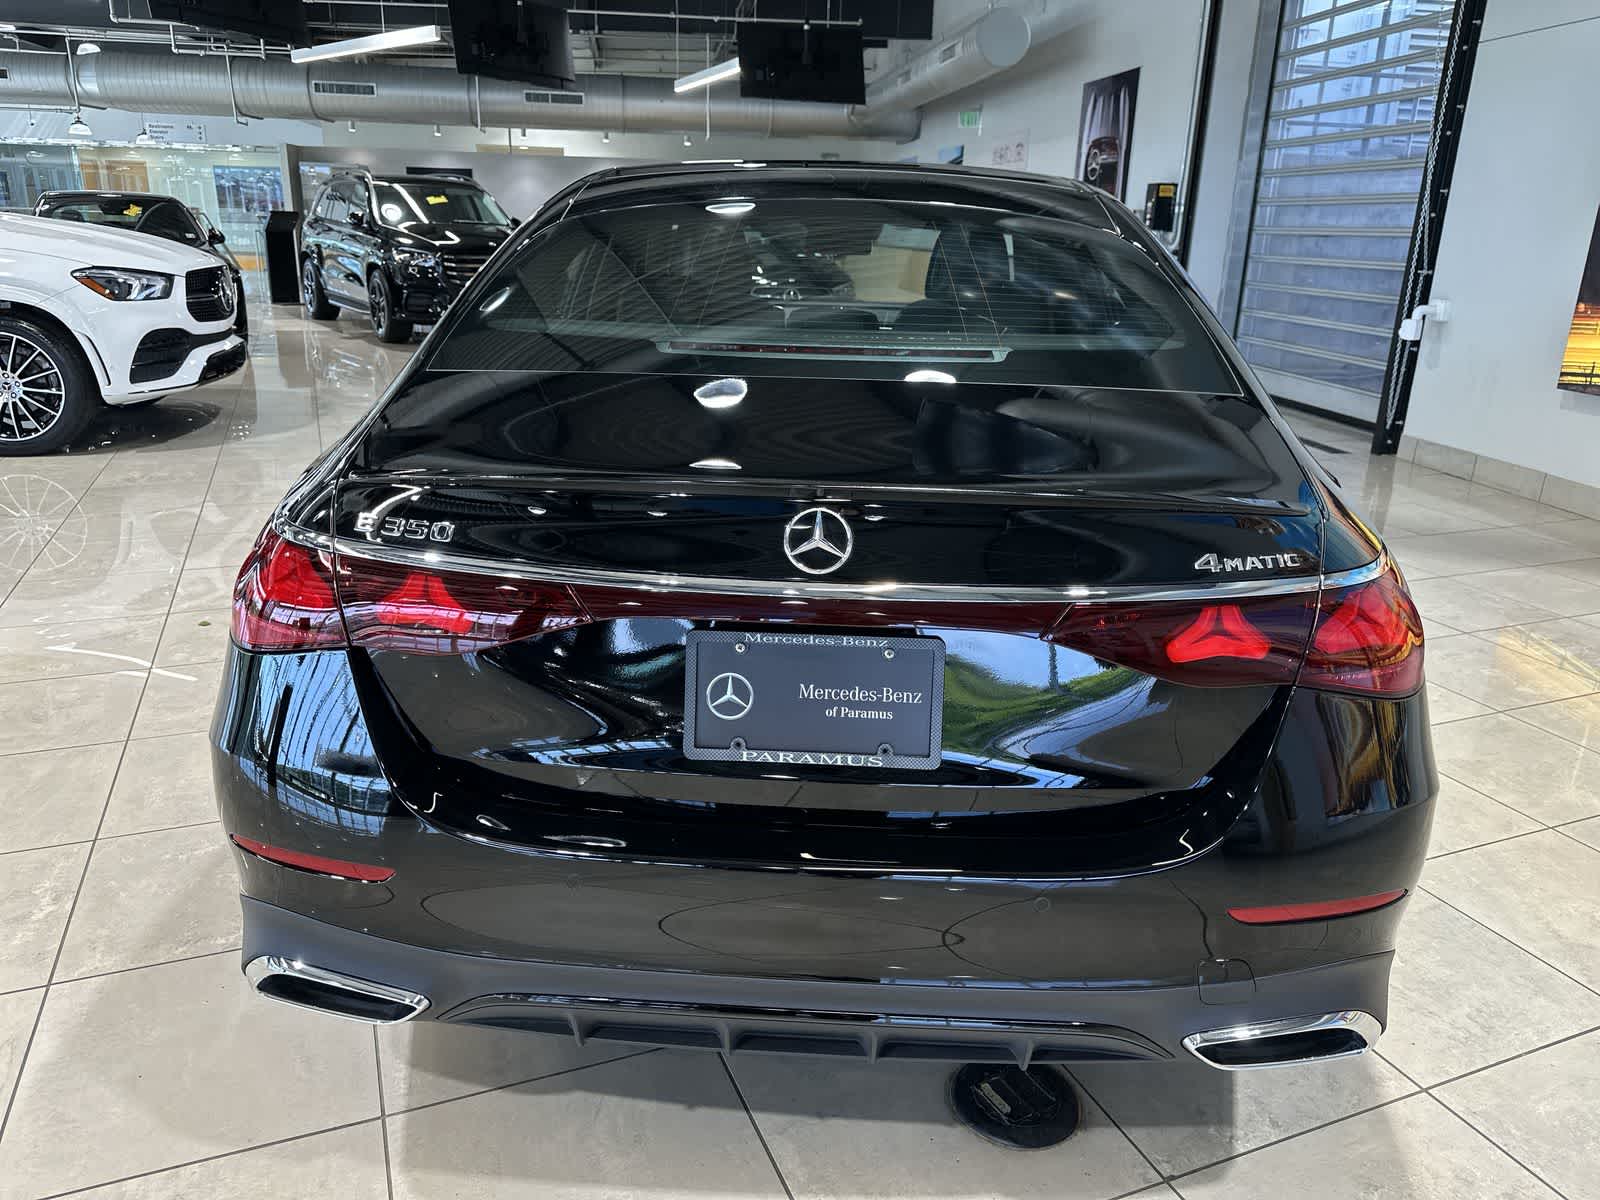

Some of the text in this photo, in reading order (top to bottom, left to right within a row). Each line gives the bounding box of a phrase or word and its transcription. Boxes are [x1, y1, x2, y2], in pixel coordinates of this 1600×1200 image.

[1194, 553, 1301, 573] 4MATIC
[744, 632, 888, 648] Mercedes-Benz
[799, 683, 922, 704] Mercedes-Benz
[825, 706, 893, 720] of Paramus
[742, 751, 883, 768] PARAMUS
